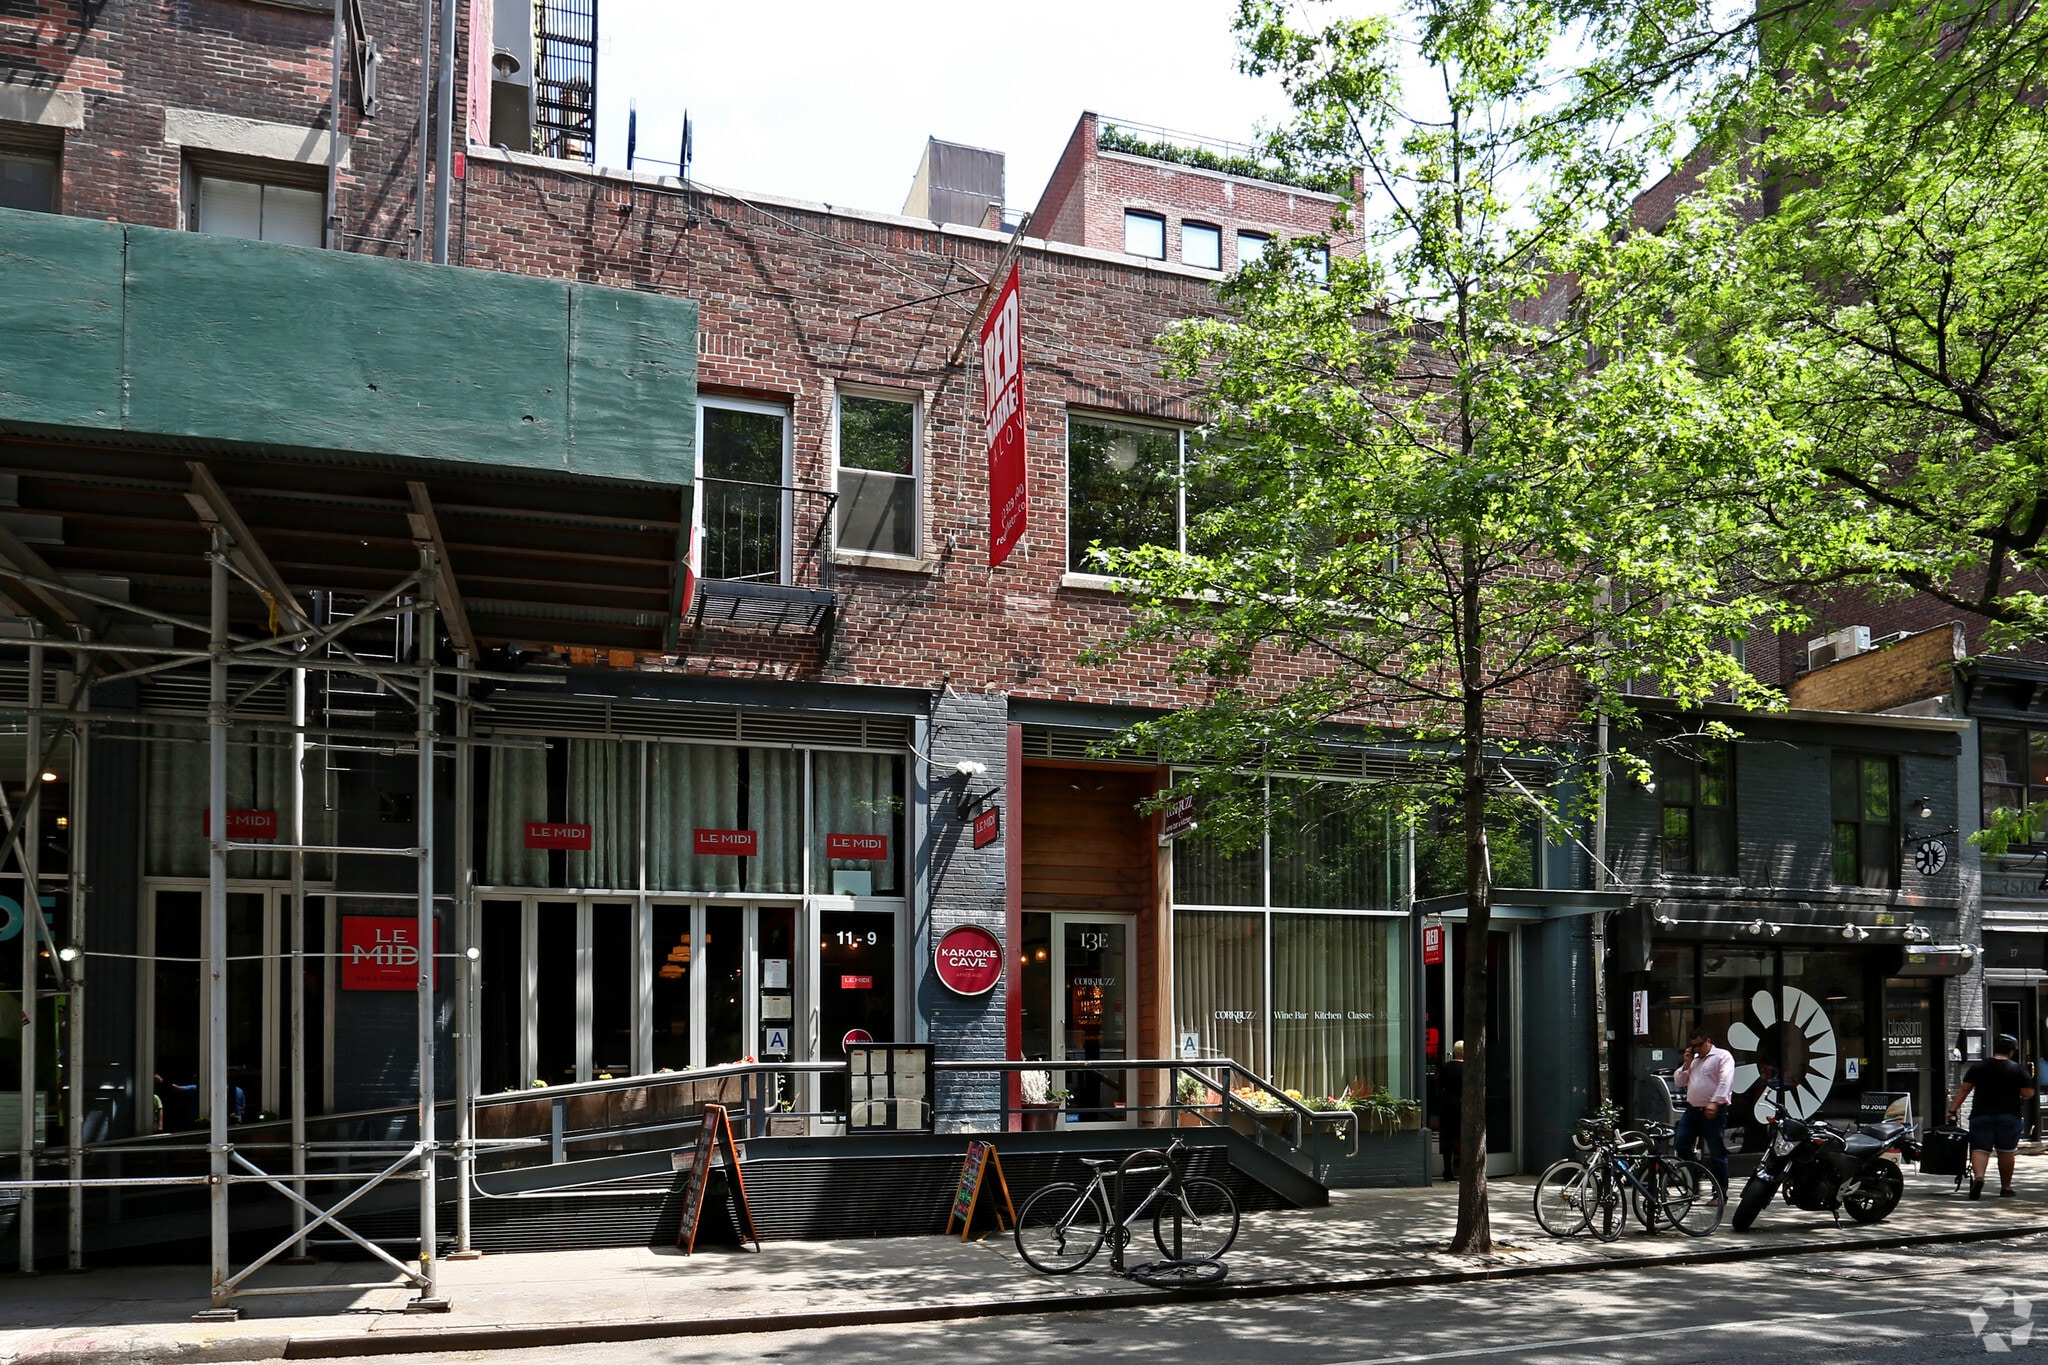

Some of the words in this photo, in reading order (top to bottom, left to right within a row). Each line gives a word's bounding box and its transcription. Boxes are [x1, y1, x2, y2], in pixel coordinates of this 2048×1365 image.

[983, 289, 1019, 421] RED
[235, 815, 271, 826] MIDI
[531, 827, 551, 838] LE
[553, 828, 585, 838] MIDI
[700, 833, 719, 843] LE
[721, 834, 752, 844] MIDI
[832, 838, 851, 848] LE
[853, 839, 882, 849] MIDI
[375, 928, 409, 943] LE
[1080, 932, 1109, 951] 13E
[1426, 929, 1439, 946] RED
[351, 944, 419, 966] MID
[941, 948, 998, 958] KARAOKE
[949, 957, 988, 968] CAVE
[1214, 1010, 1257, 1024] CORKBUZZ
[1274, 1010, 1293, 1020] Wine
[1295, 1010, 1308, 1020] Bar
[1314, 1010, 1342, 1020] Kitchen
[1347, 1010, 1375, 1020] Classes
[1887, 1018, 1922, 1037] blossom
[770, 1031, 784, 1048] A
[1184, 1036, 1196, 1050] A
[1888, 1037, 1900, 1045] DU
[1901, 1037, 1922, 1045] JOUR
[1848, 1061, 1857, 1073] A
